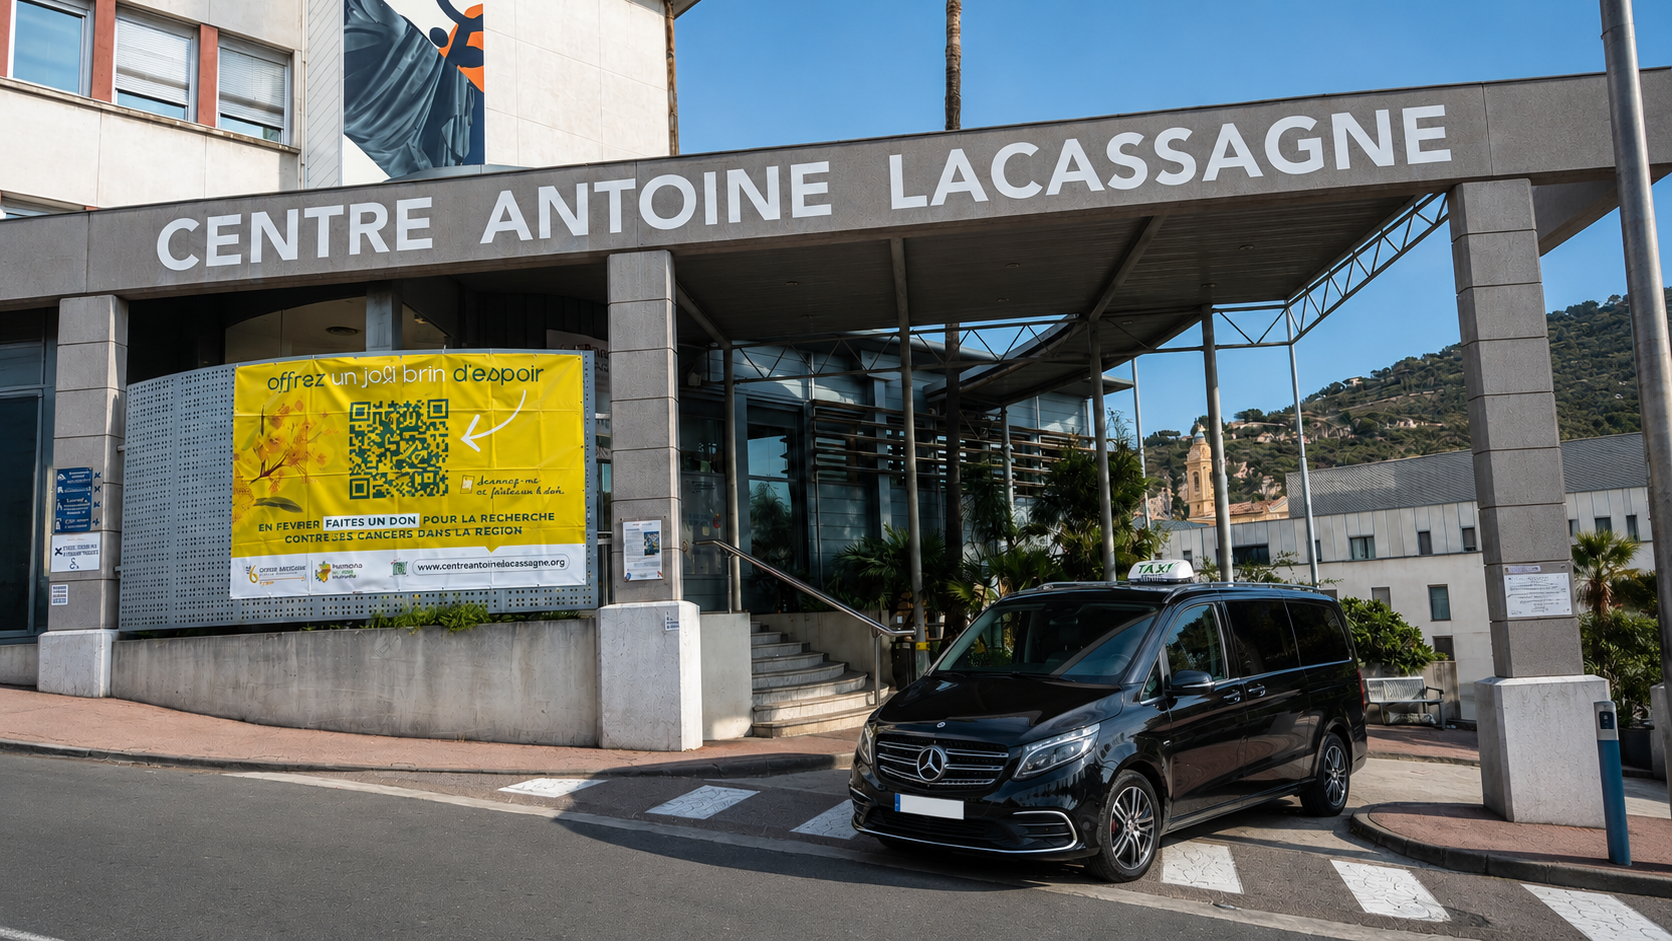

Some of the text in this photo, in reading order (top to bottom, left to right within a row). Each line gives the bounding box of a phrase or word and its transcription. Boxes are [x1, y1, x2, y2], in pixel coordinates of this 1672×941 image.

[157, 104, 1452, 271] CENTRE ANTOINE LACASSAGNE
[267, 371, 326, 393] offrez
[331, 371, 357, 385] un
[403, 364, 446, 383] brin
[453, 364, 544, 386] d'espoir
[258, 523, 273, 532] EN
[325, 518, 365, 528] FAITES
[368, 517, 386, 526] UN
[389, 515, 416, 526] DON
[423, 514, 458, 525] POUR
[461, 514, 476, 523] LA
[480, 512, 555, 523] RECHERCHE
[285, 533, 330, 544] CONTRE
[357, 529, 413, 540] CANCERS
[418, 528, 451, 538] DANS
[455, 528, 471, 537] LA
[475, 526, 523, 536] REGION
[1138, 563, 1174, 574] TAXI
